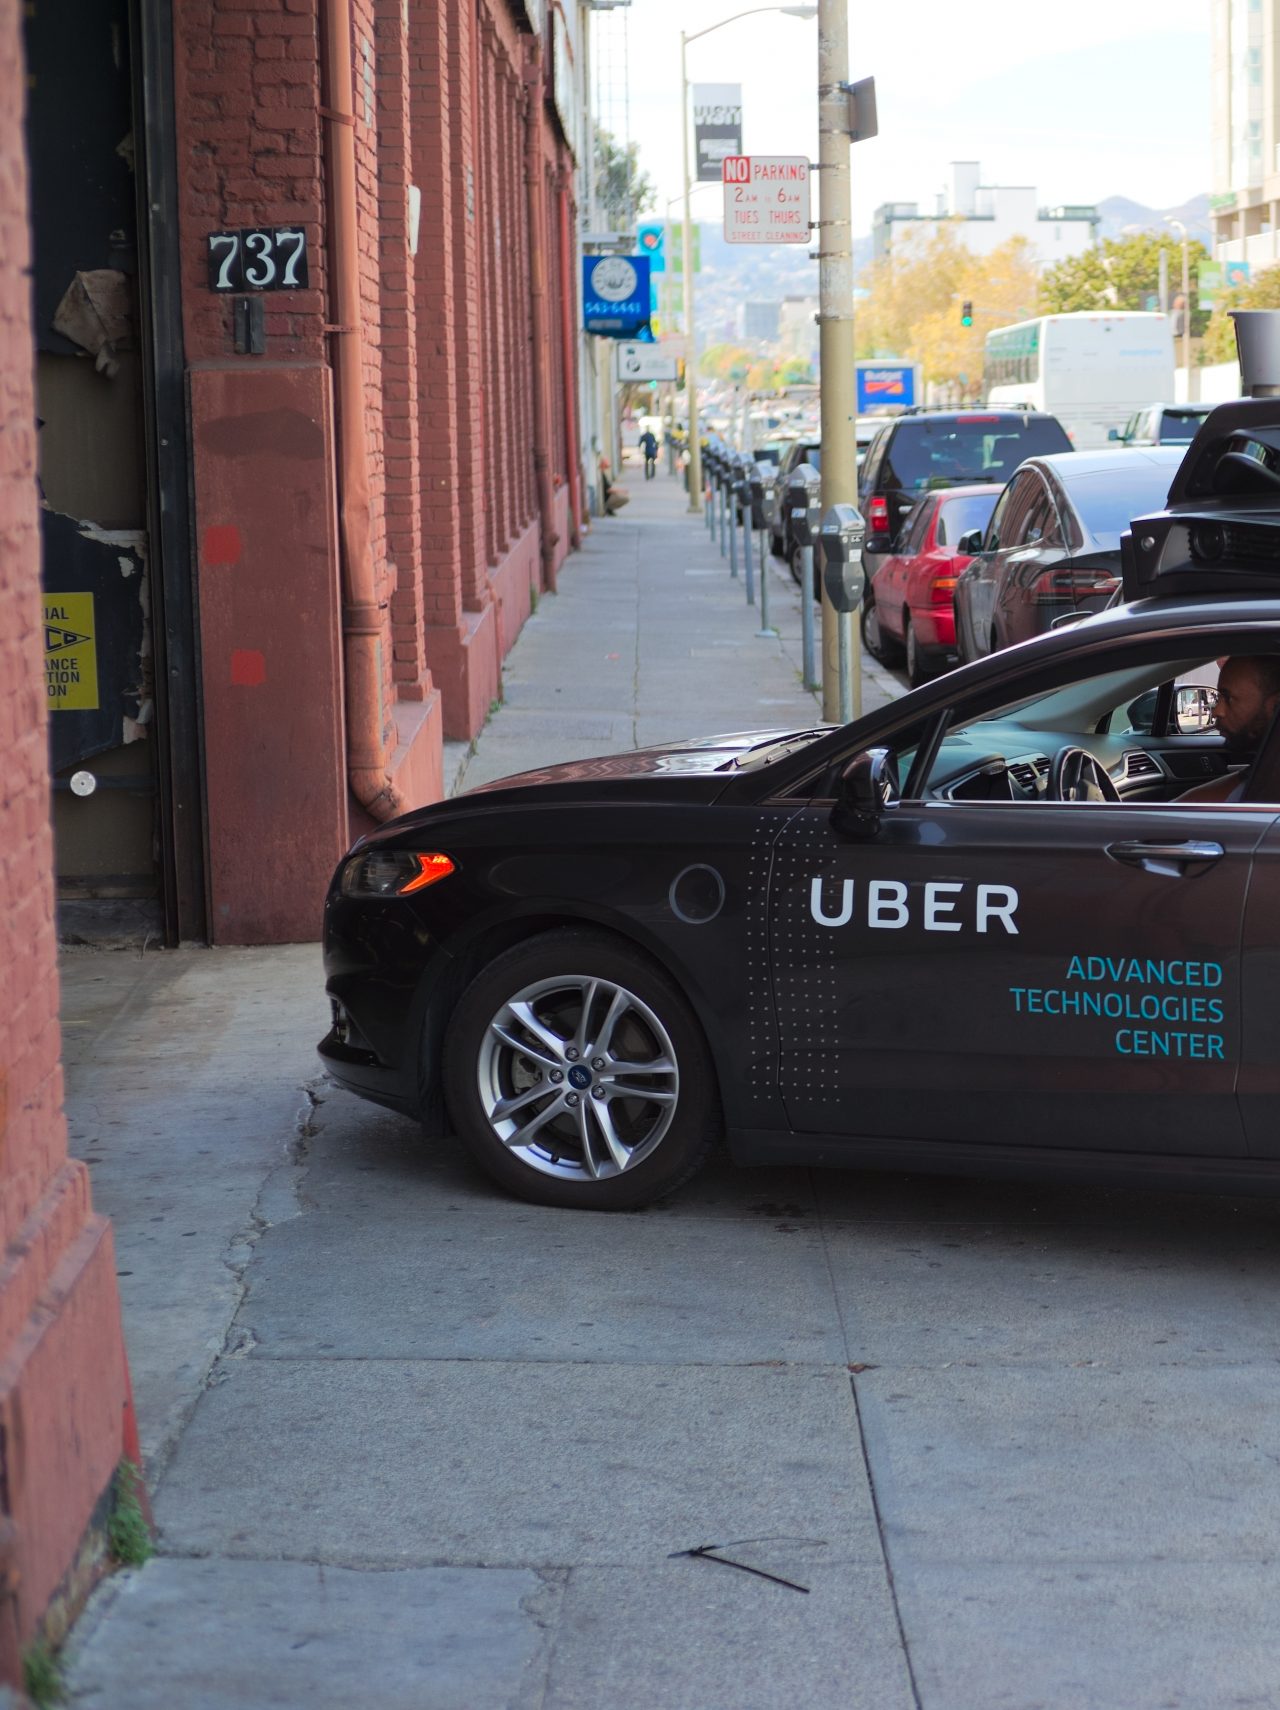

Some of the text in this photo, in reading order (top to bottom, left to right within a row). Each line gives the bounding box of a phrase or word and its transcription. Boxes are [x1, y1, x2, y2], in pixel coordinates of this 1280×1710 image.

[725, 158, 806, 182] NO PARKING
[734, 210, 801, 224] TUES THURS
[732, 231, 804, 241] STREET CLEANING
[209, 231, 305, 289] 737
[43, 607, 69, 620] IAL
[48, 671, 80, 684] TION
[48, 685, 67, 697] ON
[810, 877, 1021, 936] UBER
[1065, 955, 1223, 988] ADVANCED
[1009, 988, 1224, 1024] TECHNOLOGIES
[1114, 1029, 1225, 1060] CENTER
